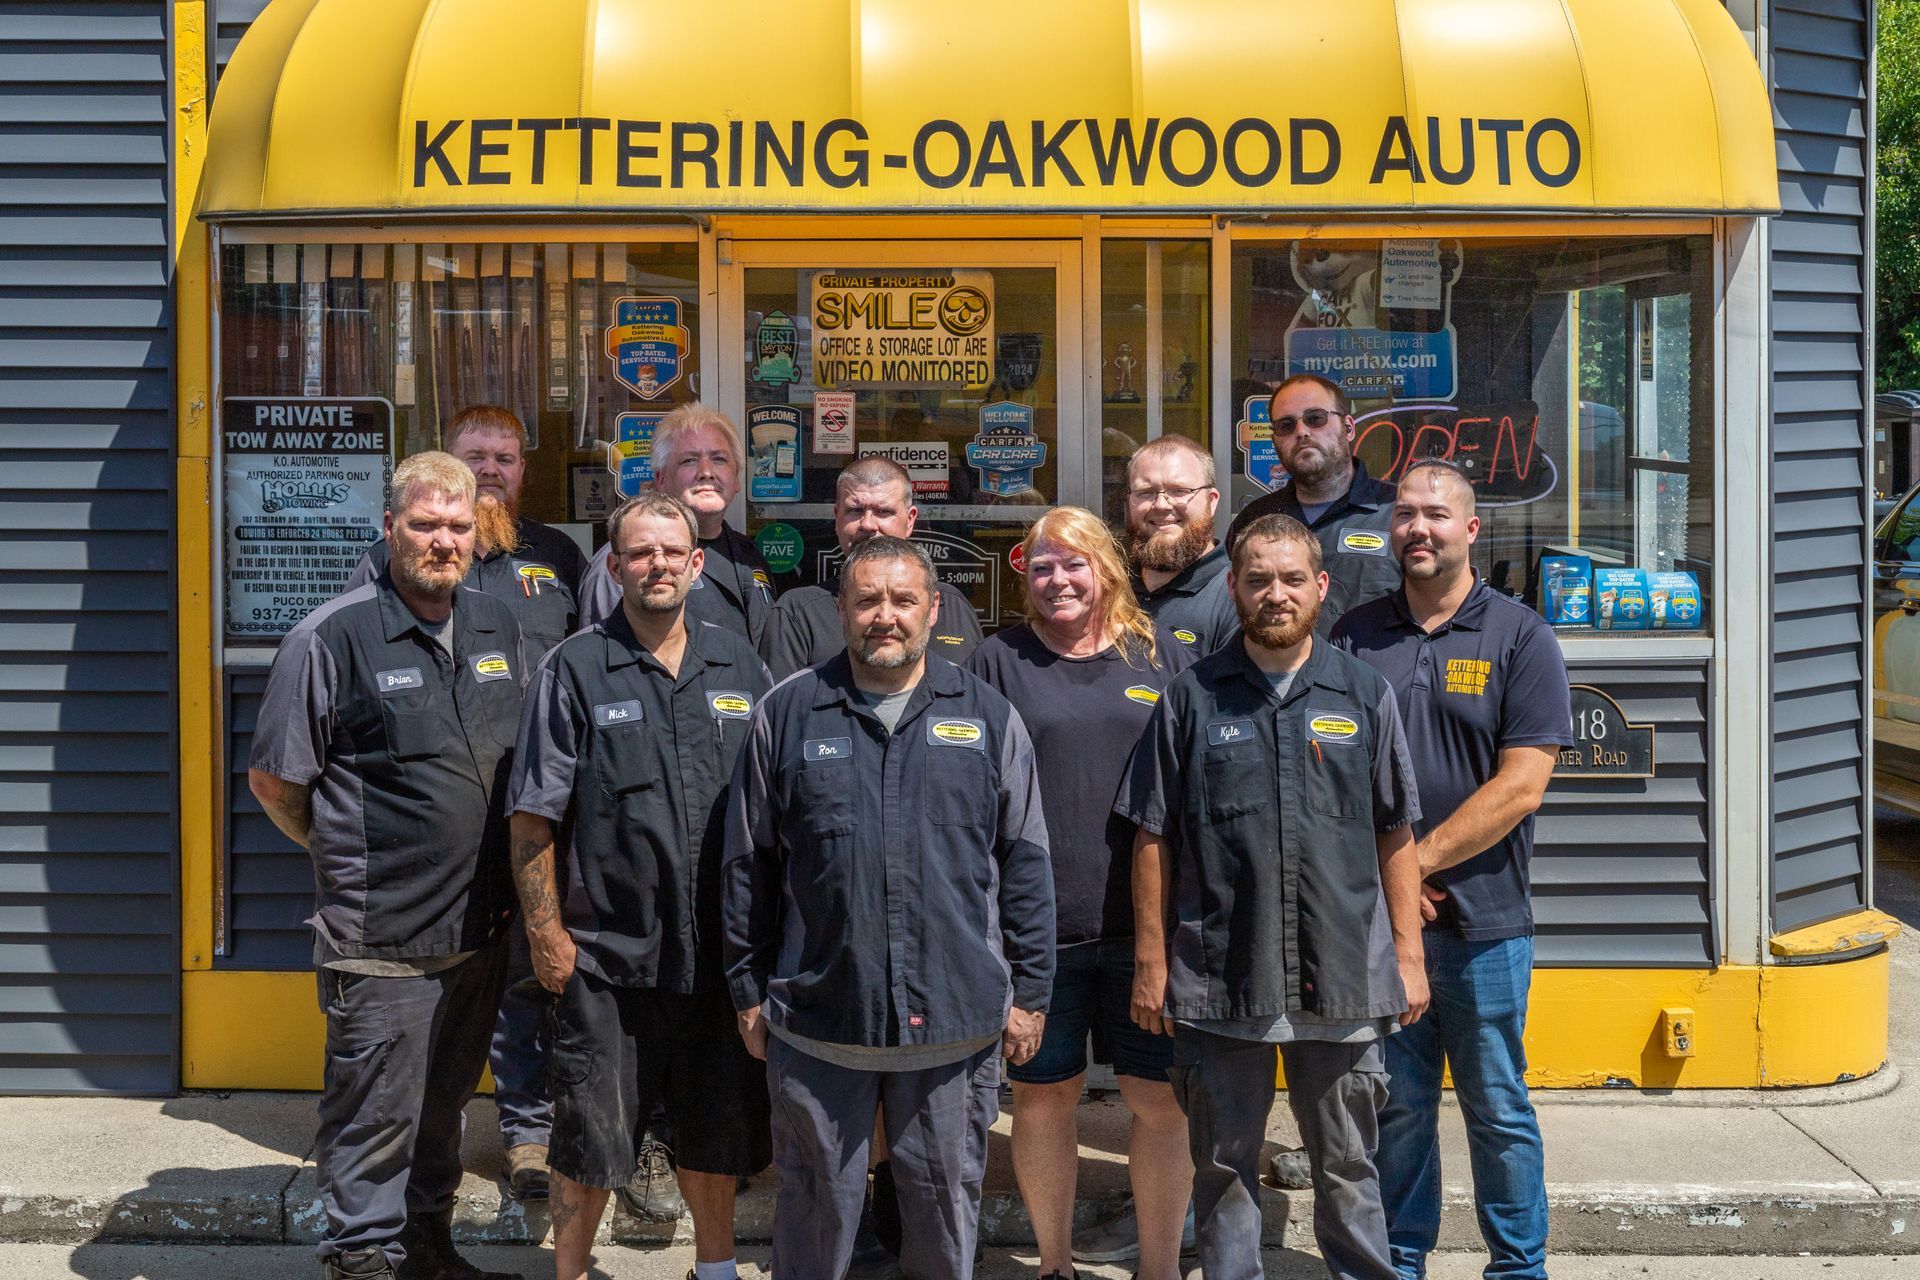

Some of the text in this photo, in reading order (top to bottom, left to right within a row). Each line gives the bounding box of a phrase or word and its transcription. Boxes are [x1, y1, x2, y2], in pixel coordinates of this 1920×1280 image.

[414, 116, 1582, 189] KETTERING-OAKWOOD AUTO
[1387, 248, 1434, 258] Oakwood
[1383, 258, 1438, 268] Automotive
[821, 276, 874, 287] PRIVATE
[880, 276, 951, 287] PROPERTY
[816, 292, 937, 330] SMILE
[1319, 307, 1352, 327] FOX
[761, 330, 793, 344] BEST
[761, 344, 792, 352] DAYTON
[820, 337, 988, 356] OFFICE & STORAGE LOT ARE
[1317, 336, 1424, 351] Get it FREE now at
[621, 357, 676, 365] SERVICE CENTER
[1304, 352, 1437, 374] mycarfax.com
[818, 360, 989, 384] VIDEO MONITORED
[1008, 364, 1033, 376] 2024
[1346, 375, 1404, 385] CARFAX
[255, 405, 354, 427] PRIVATE
[752, 411, 797, 423] WELCOME
[984, 411, 1029, 423] WELCOME
[225, 431, 384, 449] TOW AWAY ZONE
[980, 438, 1034, 447] CARFAX
[972, 450, 1039, 459] CAR CARE
[273, 456, 339, 467] K.O. AUTOMOTIVE
[247, 471, 371, 481] AUTHORIZED PARKING ONLY
[260, 480, 351, 503] HOLLIS
[916, 482, 948, 491] Warranty
[286, 498, 329, 509] TOWING
[254, 516, 286, 524] SEMINARY
[304, 516, 330, 525] DAYTON,
[240, 528, 374, 539] TOWING IS ENFORCED 24 HOURS PER DAY
[240, 545, 354, 555] FAILURE TO RECOVER A TOWED VEHICLE MAY
[762, 545, 794, 556] FAVE
[236, 558, 356, 568] IN THE LOSS OF THE TITLE TO THE VEHICLE AND
[231, 571, 263, 580] OWNERSHIP
[264, 571, 271, 580] OF
[272, 571, 282, 580] THE
[307, 571, 315, 580] AS
[315, 571, 342, 580] PROVIDED
[343, 571, 349, 580] IN
[946, 572, 985, 584] 5:00PM
[244, 583, 251, 593] OF
[252, 583, 274, 593] SECTION
[299, 583, 306, 593] OF
[308, 583, 318, 593] THE
[318, 583, 332, 593] OHIO
[273, 597, 336, 606] PUCO 603
[252, 608, 317, 621] 937-25
[1447, 659, 1491, 674] KETTERING
[387, 675, 413, 686] Brian
[1446, 683, 1484, 696] AUTOMOTIVE
[608, 708, 628, 720] Nick
[1570, 709, 1607, 740] 18
[1220, 725, 1240, 741] Kyle
[818, 744, 837, 756] Ron
